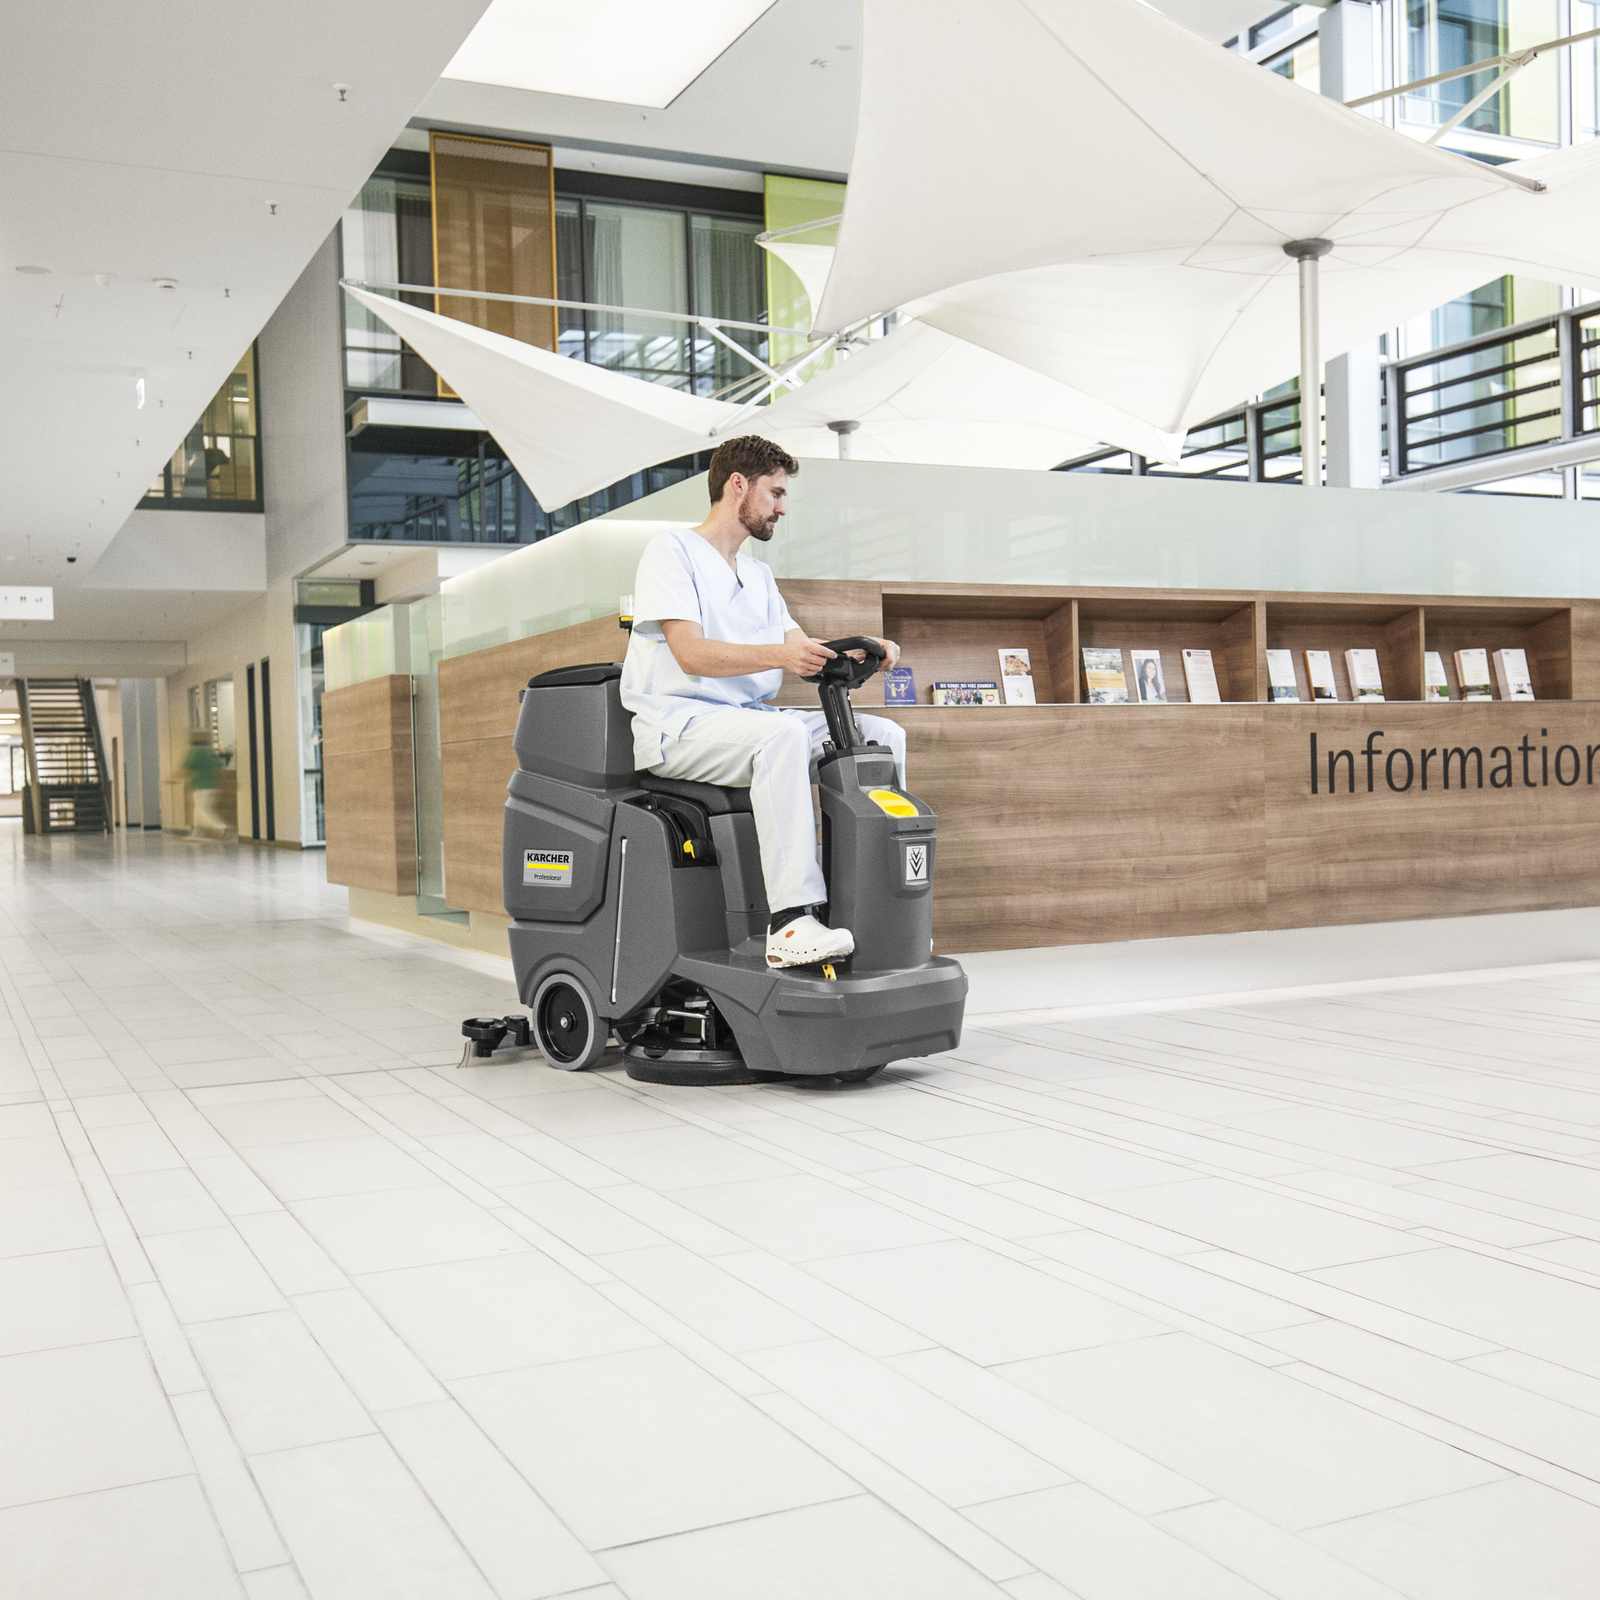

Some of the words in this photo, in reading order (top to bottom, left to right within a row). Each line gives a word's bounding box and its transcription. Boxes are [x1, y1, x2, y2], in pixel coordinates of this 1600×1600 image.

[1310, 728, 1600, 795] Information
[527, 852, 570, 864] KÄRCHER
[533, 873, 562, 881] Professional
